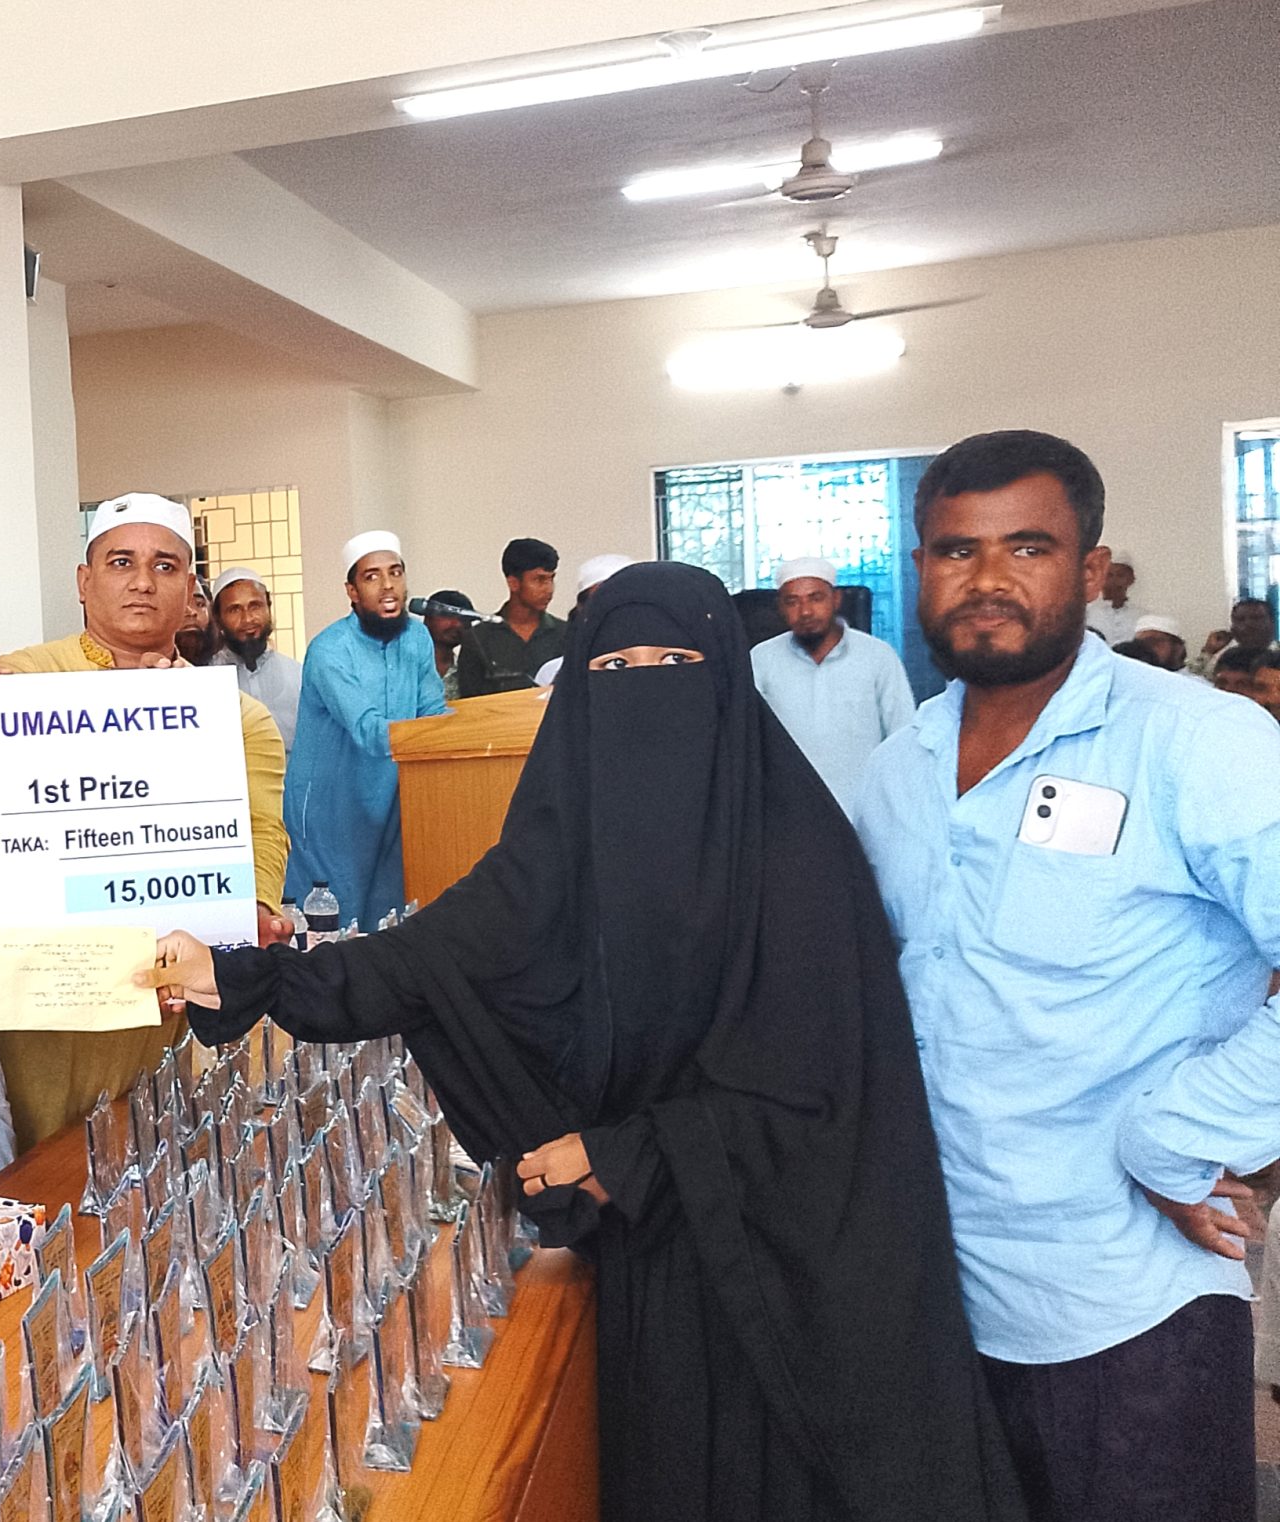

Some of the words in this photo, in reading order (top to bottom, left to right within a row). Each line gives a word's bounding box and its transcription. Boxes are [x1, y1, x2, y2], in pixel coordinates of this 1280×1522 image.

[102, 705, 200, 733] AKTER
[28, 778, 70, 804] 1st
[79, 776, 150, 800] Prize
[1, 836, 49, 854] TAKA:
[64, 826, 134, 850] Fifteen
[140, 819, 238, 844] Thousand
[103, 871, 232, 905] 15,000Tk
